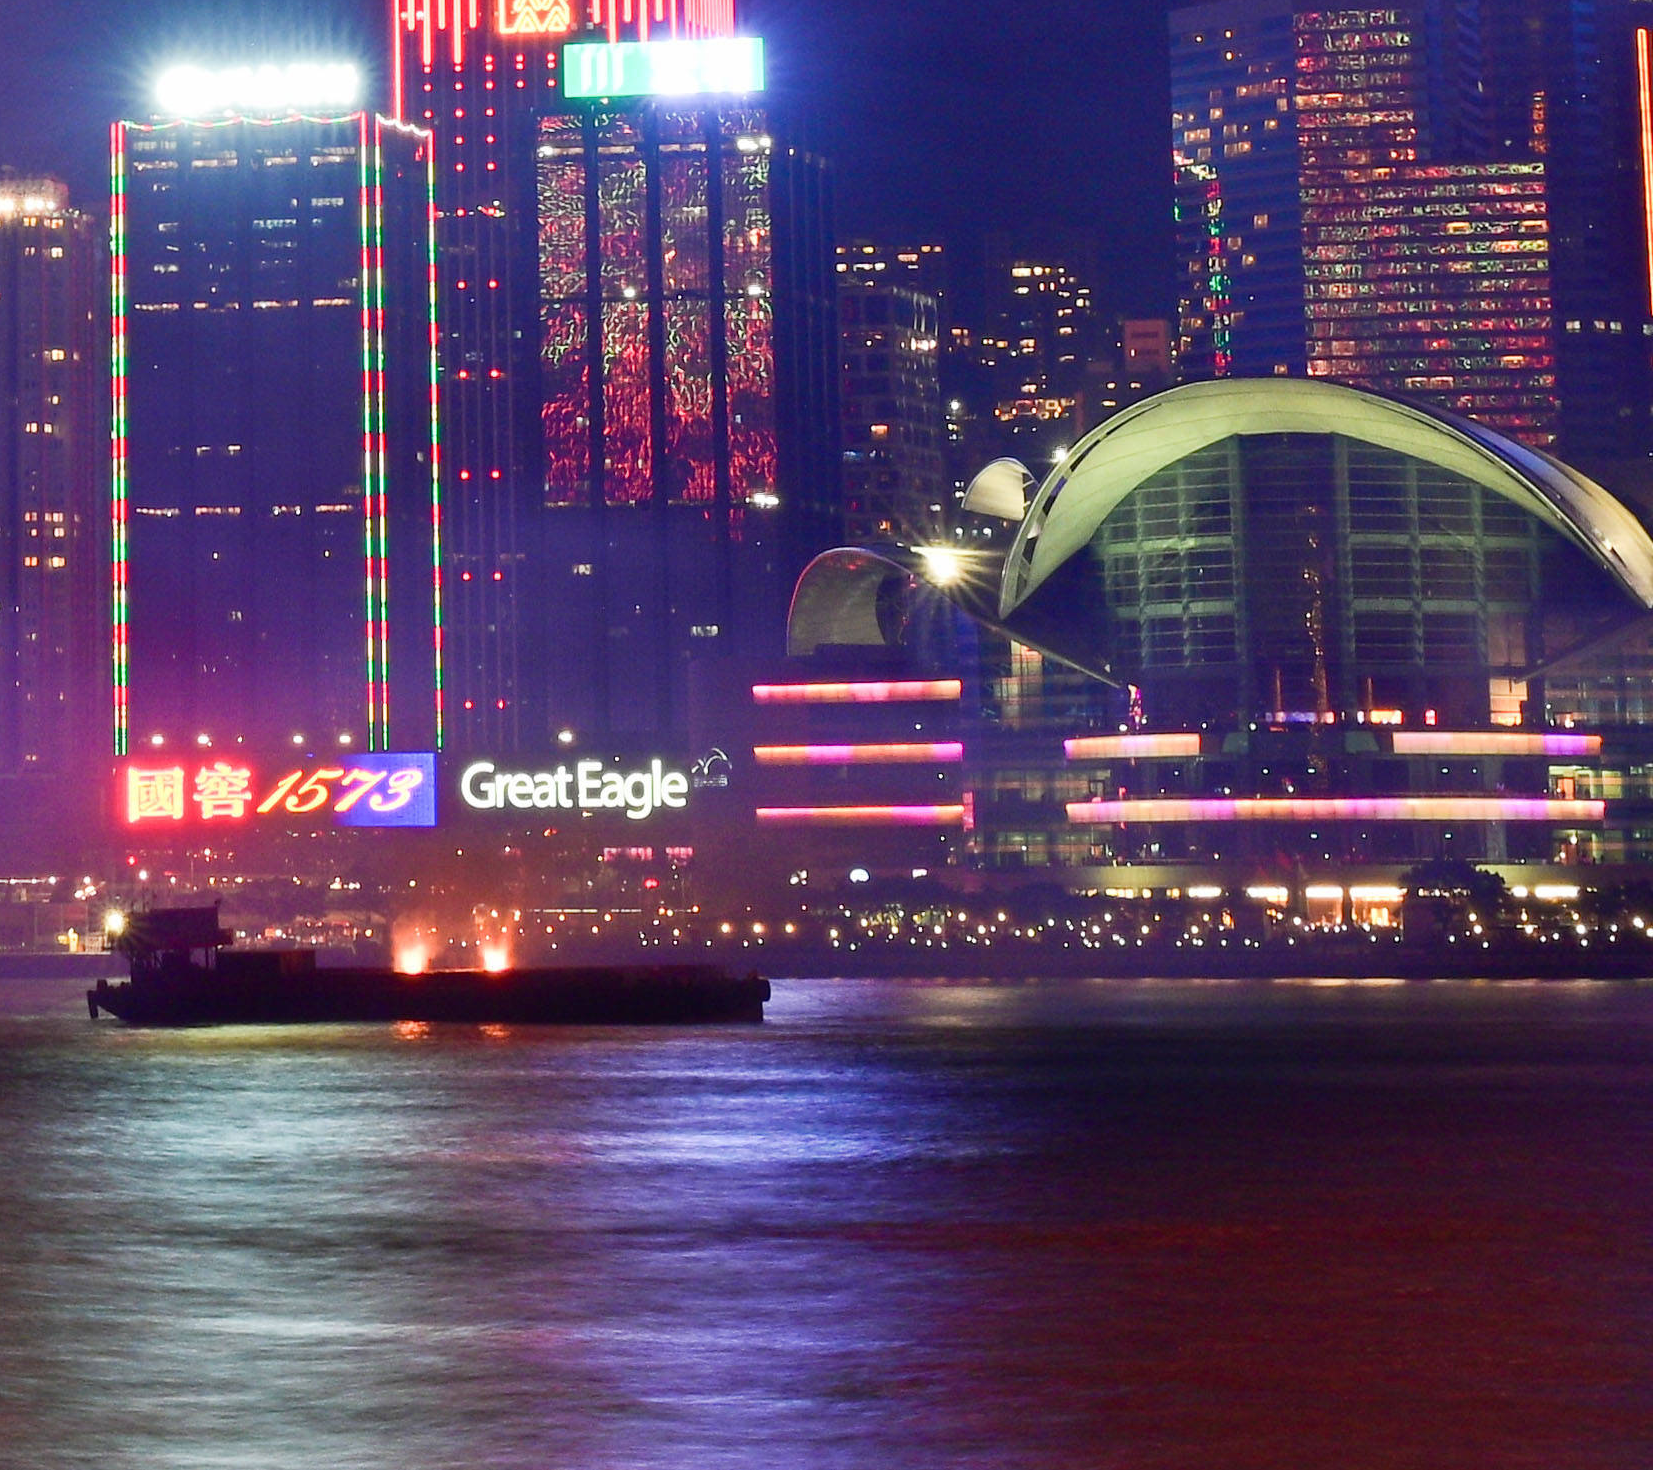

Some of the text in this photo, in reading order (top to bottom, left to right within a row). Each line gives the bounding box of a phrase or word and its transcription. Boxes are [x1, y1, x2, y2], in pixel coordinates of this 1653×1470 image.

[127, 763, 424, 822] 國窖 1573
[461, 760, 689, 819] Great Eagle
